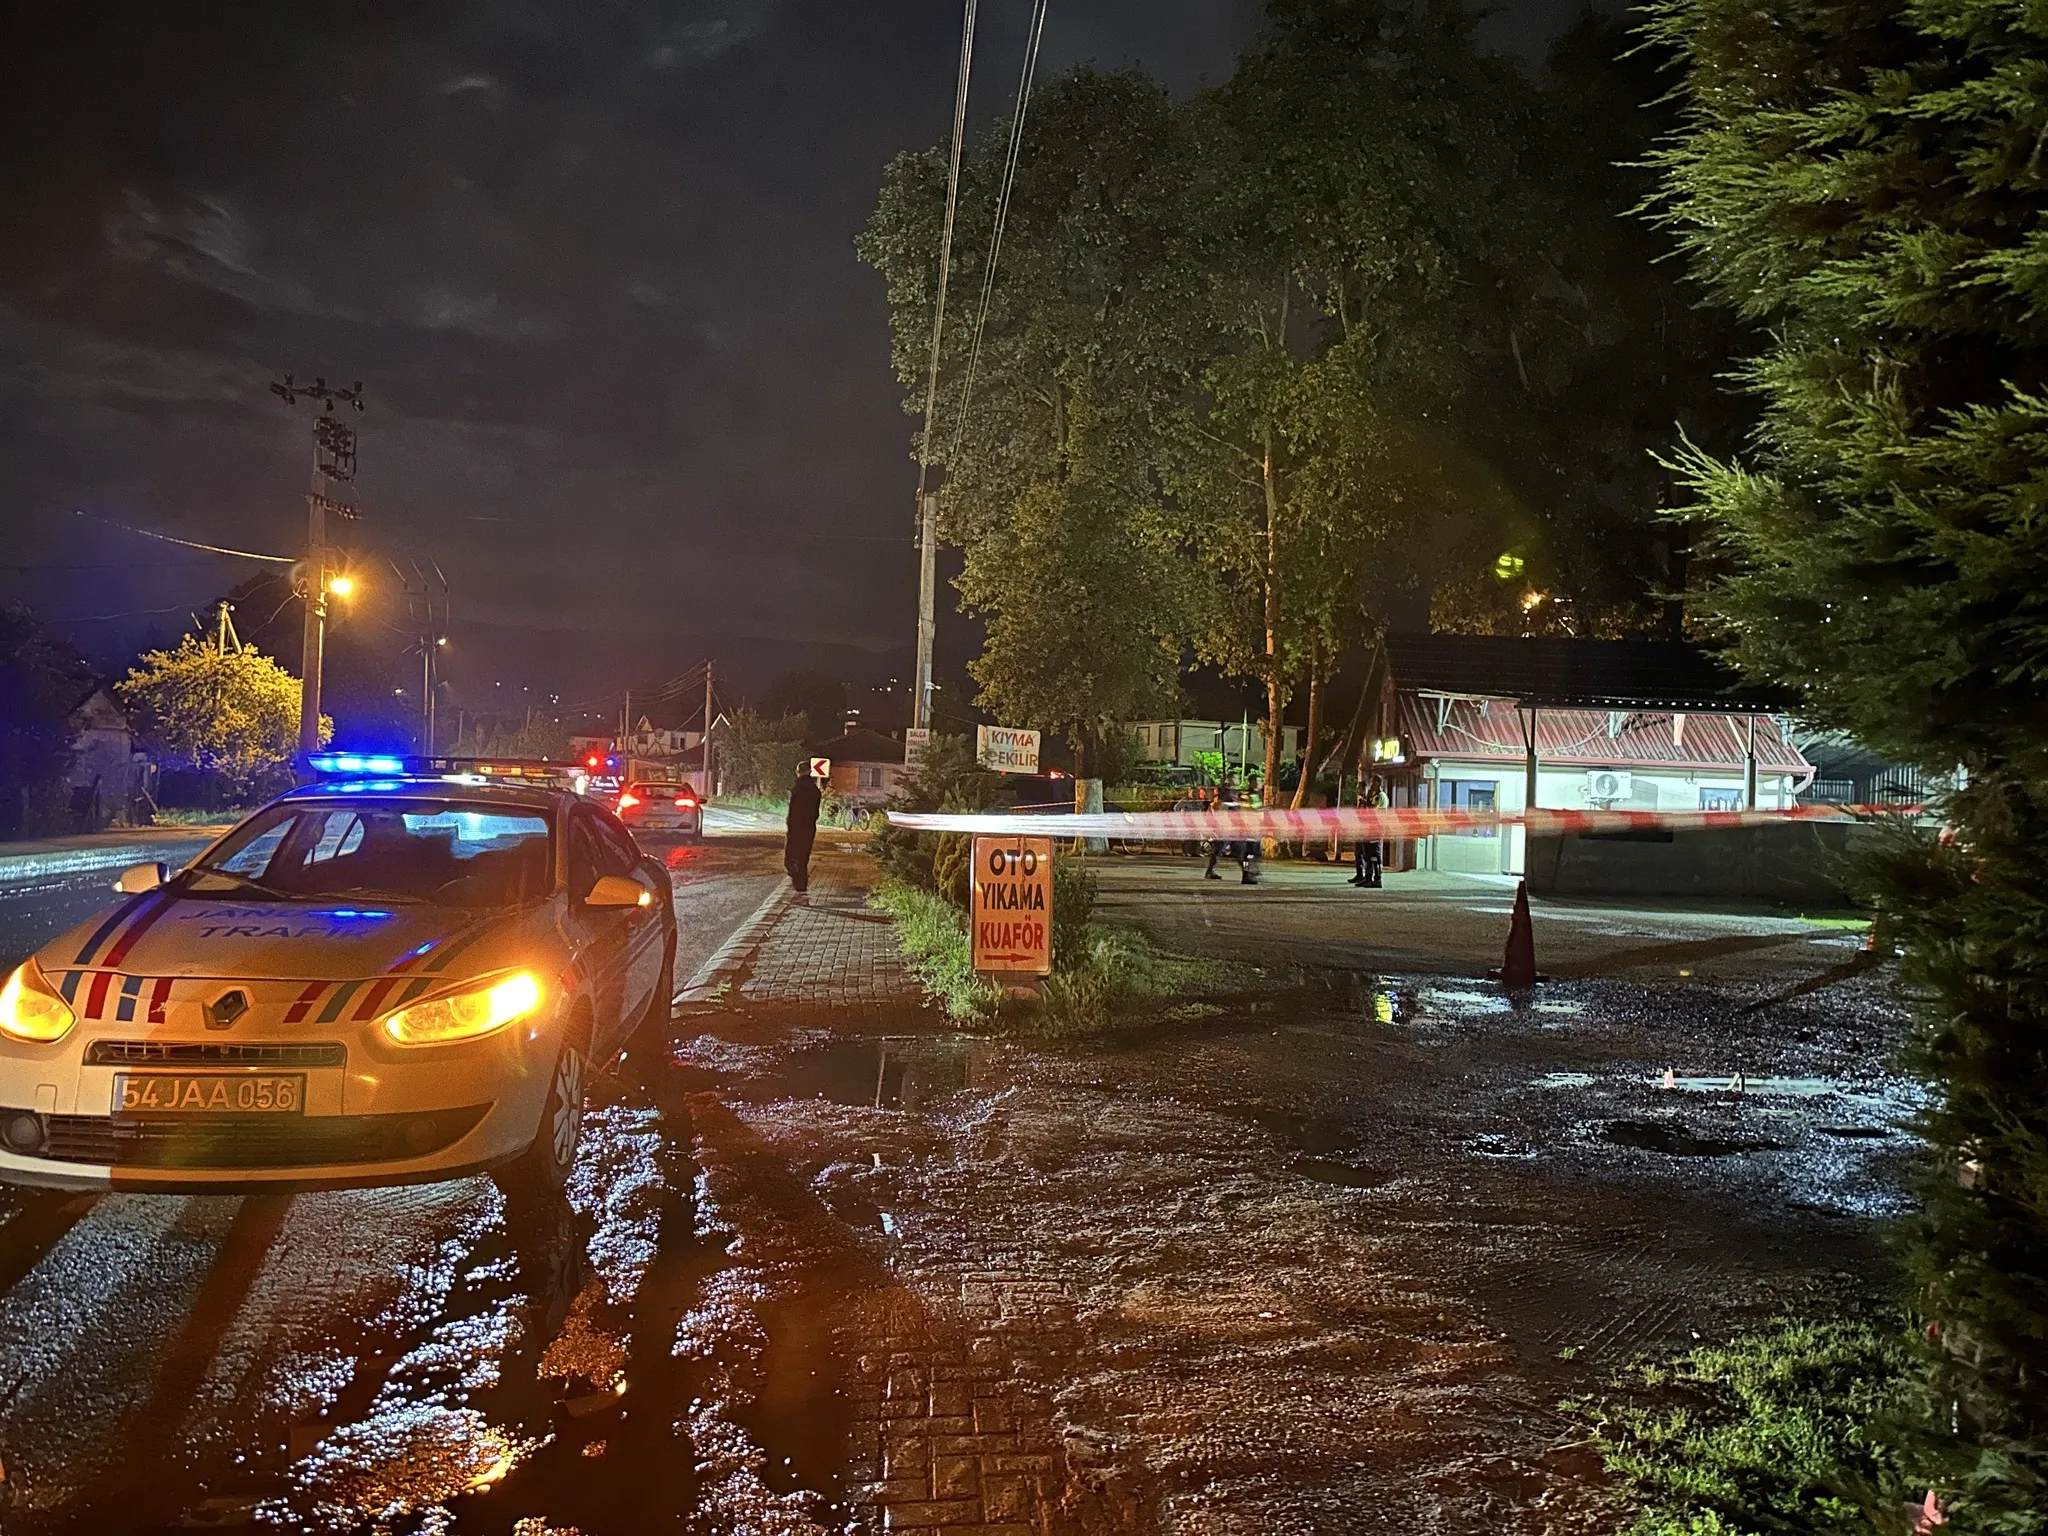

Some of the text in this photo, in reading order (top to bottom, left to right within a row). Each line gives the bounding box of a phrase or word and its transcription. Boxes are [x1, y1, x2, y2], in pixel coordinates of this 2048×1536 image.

[991, 730, 1035, 748] KIYMA
[986, 749, 1039, 767] ÇEKİLİR
[989, 848, 1038, 876] OTO
[981, 882, 1045, 911] YIKAMA
[980, 913, 1044, 950] KUAFÖR
[122, 1078, 296, 1110] 54 JAA 056
